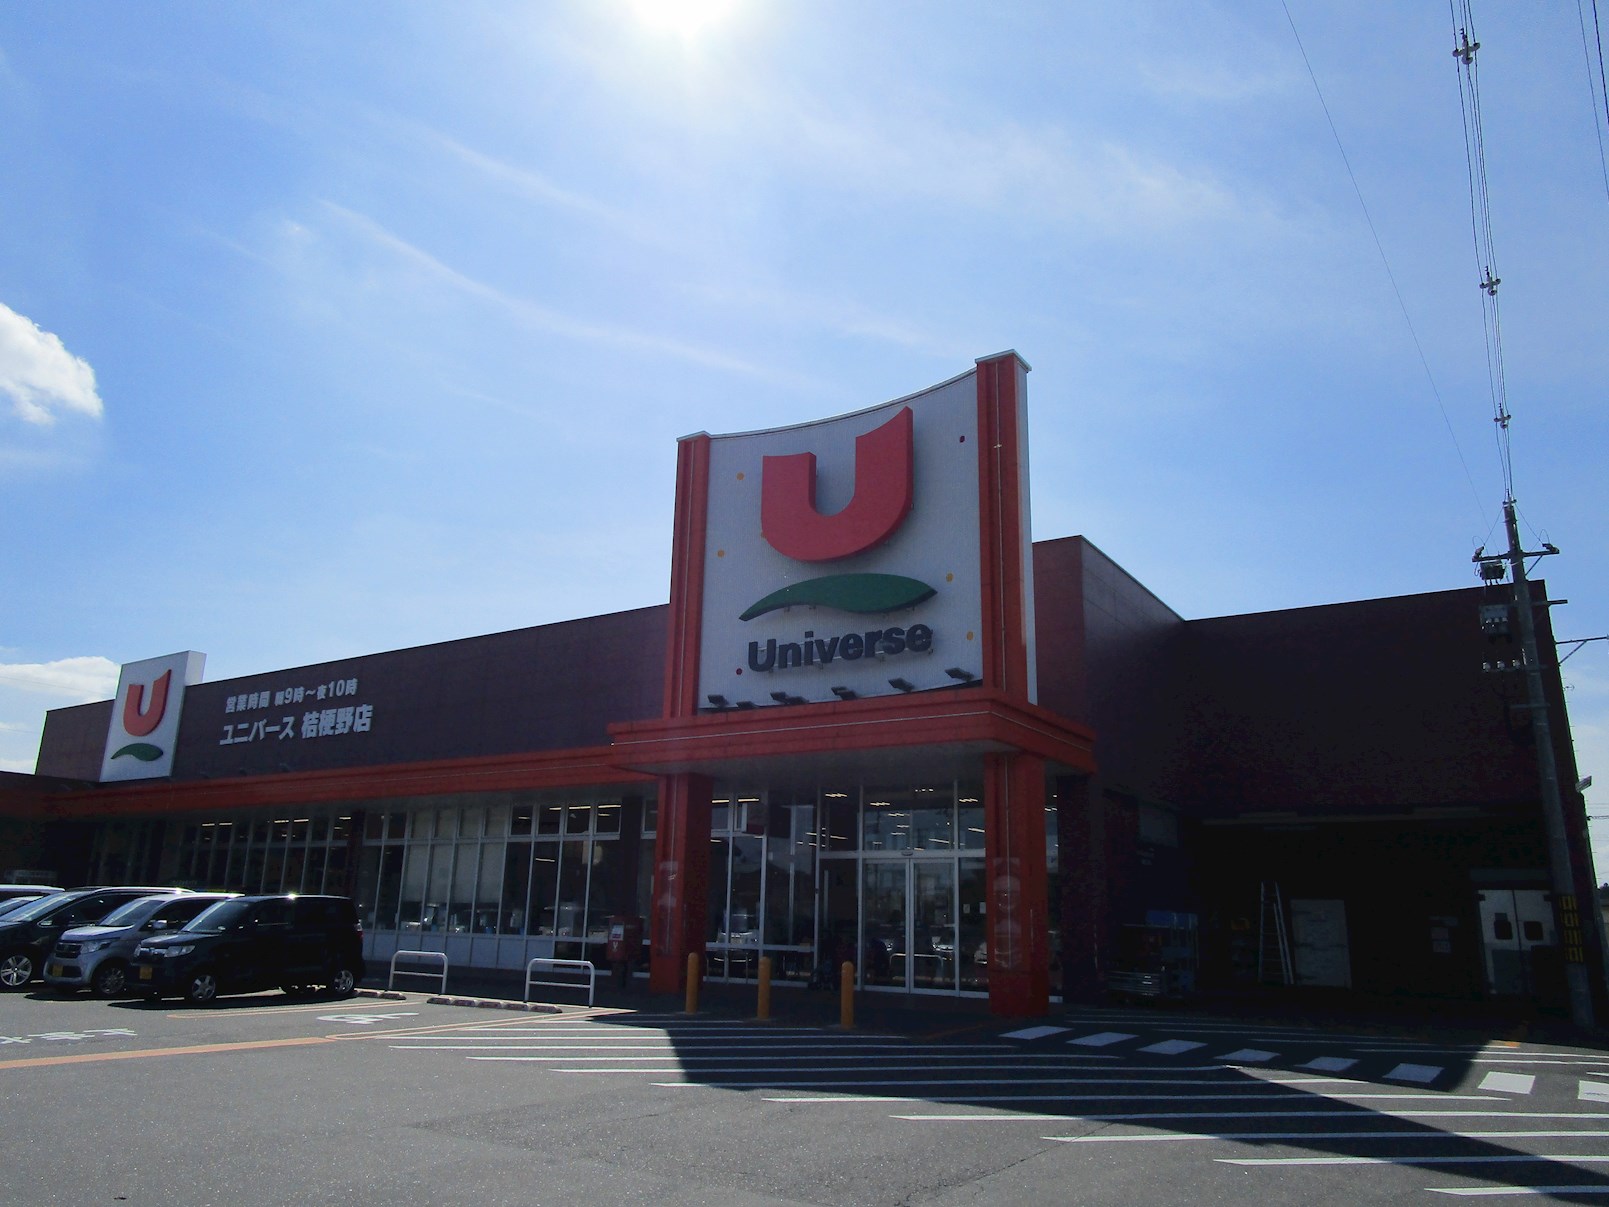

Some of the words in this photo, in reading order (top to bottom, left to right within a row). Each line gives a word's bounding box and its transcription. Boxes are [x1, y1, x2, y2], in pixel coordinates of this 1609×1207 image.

[761, 406, 914, 563] U
[748, 623, 933, 672] Universe
[219, 716, 295, 745] ユニバース
[301, 704, 373, 739] 桔梗野店
[225, 691, 271, 713] 営業時間
